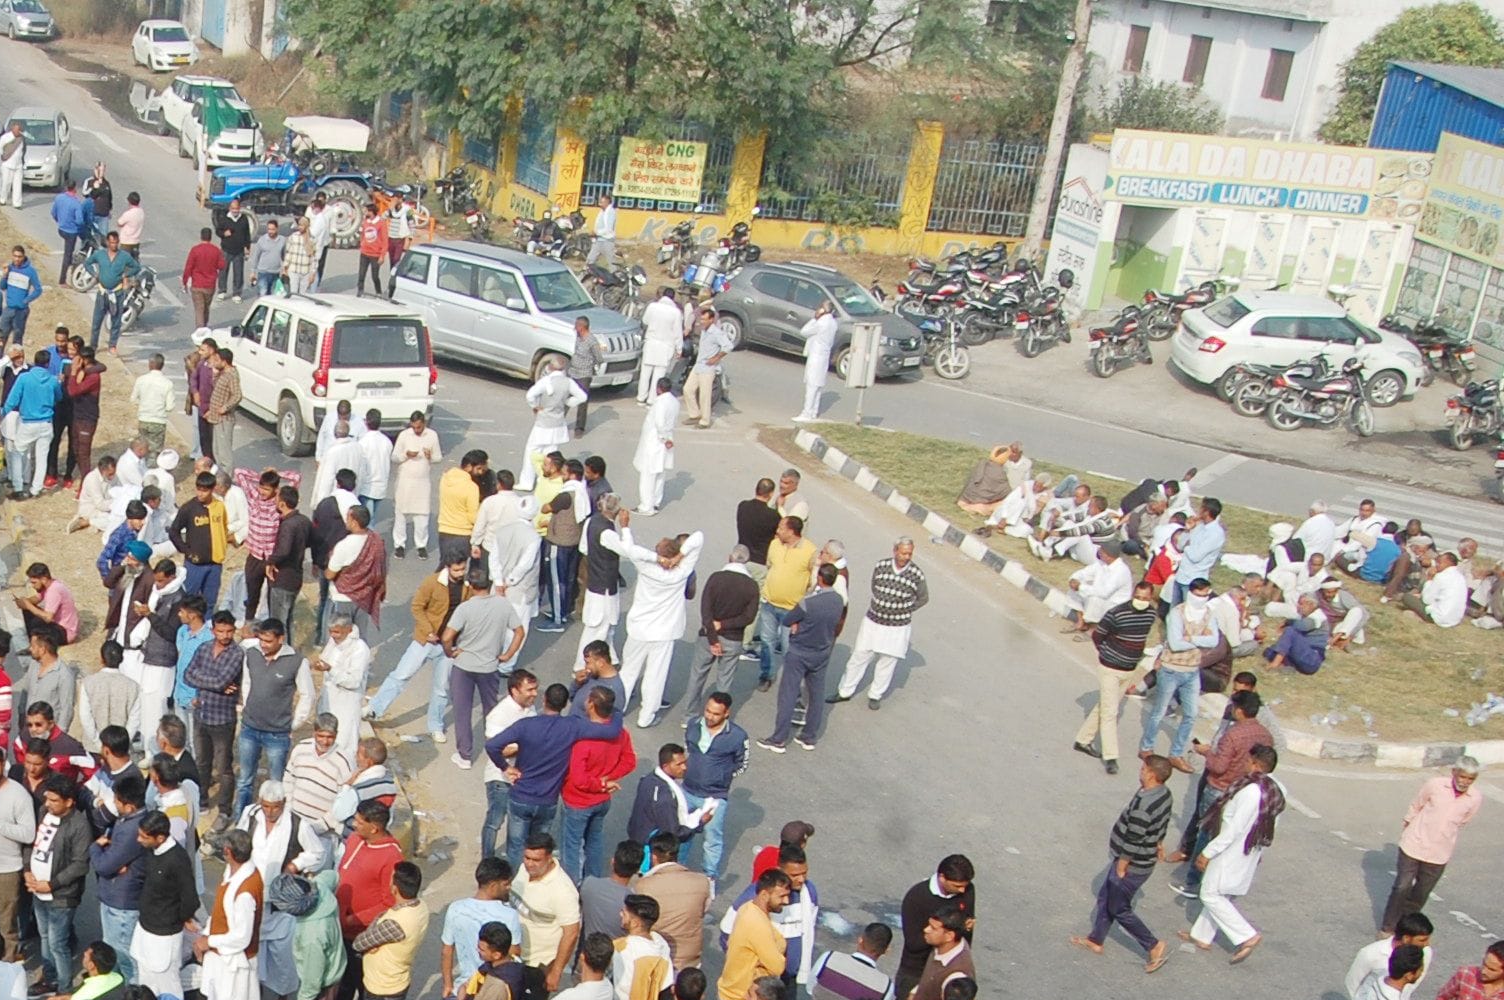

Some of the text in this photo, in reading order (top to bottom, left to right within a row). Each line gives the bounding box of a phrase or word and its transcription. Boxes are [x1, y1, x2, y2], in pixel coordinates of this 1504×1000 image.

[666, 143, 695, 157] CNG
[1197, 143, 1247, 178] DA
[1253, 149, 1375, 189] DHABA
[1117, 178, 1362, 214] BREAKFAST LUNCH DINNER
